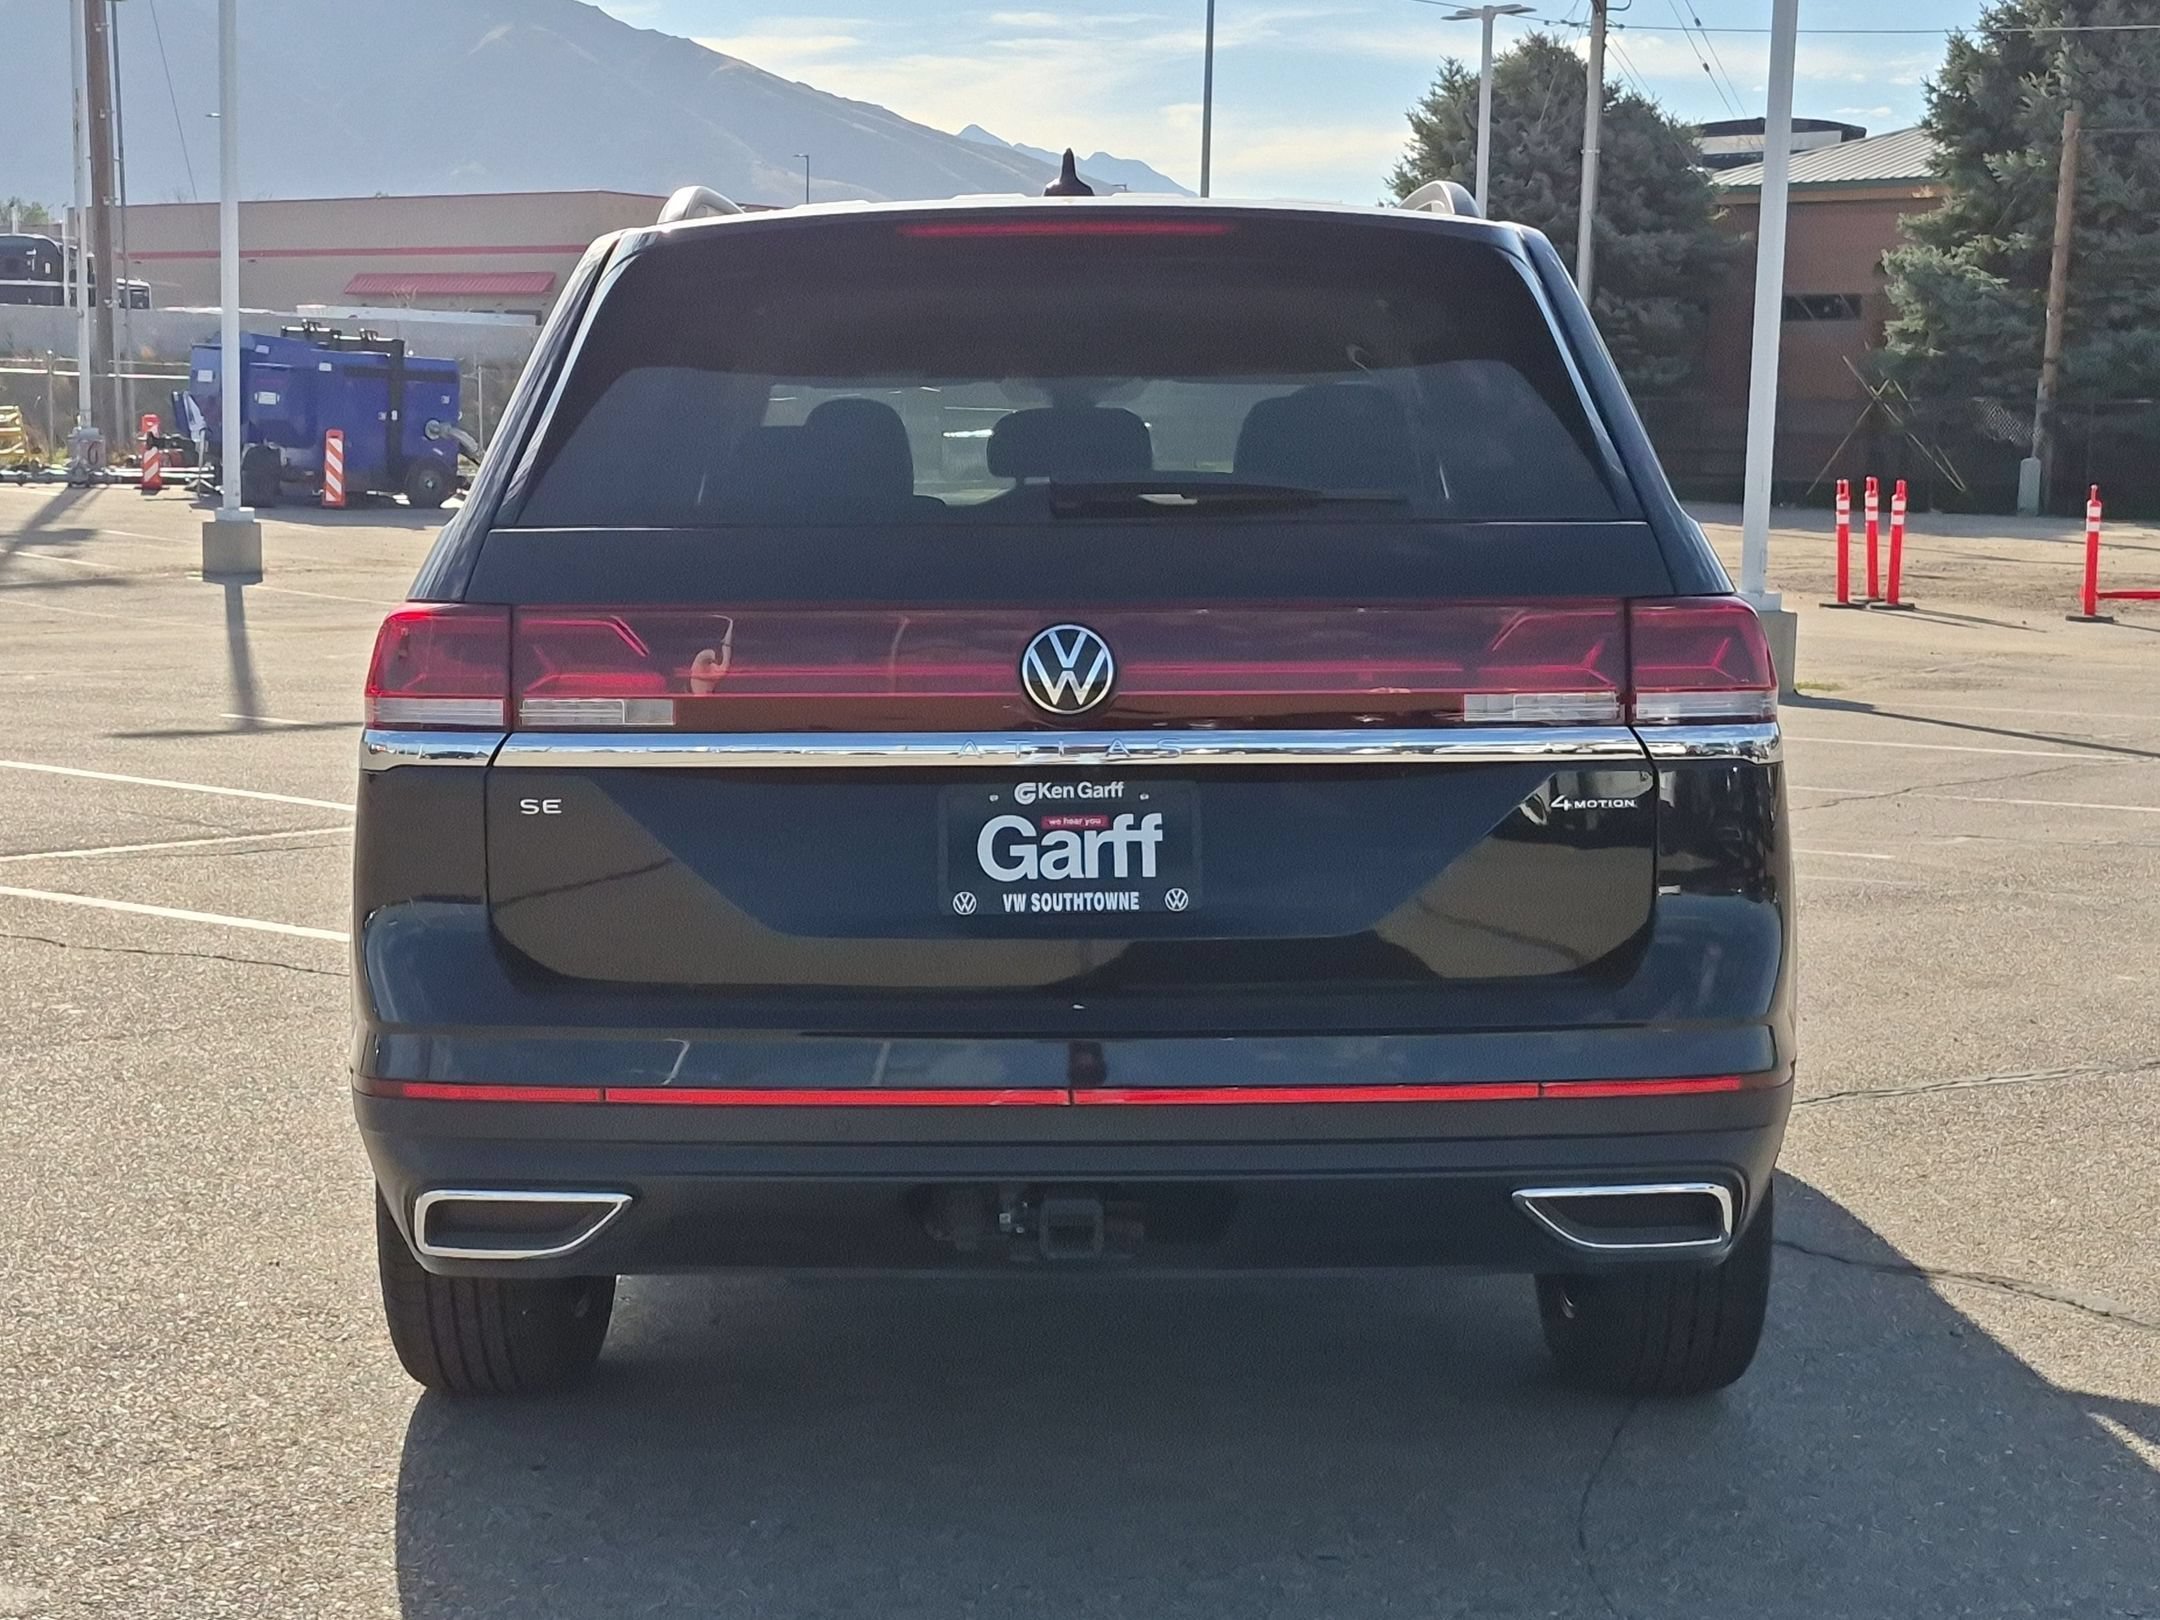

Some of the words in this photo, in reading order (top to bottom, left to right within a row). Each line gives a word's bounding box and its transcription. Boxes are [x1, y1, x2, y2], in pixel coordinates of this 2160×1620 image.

[1024, 626, 1112, 712] VW
[956, 738, 1182, 758] ATLAS
[1038, 782, 1075, 799] Ken
[1077, 781, 1124, 798] Garff
[520, 799, 562, 815] SE
[1551, 795, 1636, 811] 4MOTION
[1063, 817, 1083, 825] hear
[1084, 817, 1102, 826] you
[977, 813, 1163, 882] Garff
[1002, 893, 1026, 912] VW
[1031, 891, 1140, 912] SOUTHTOWNE
